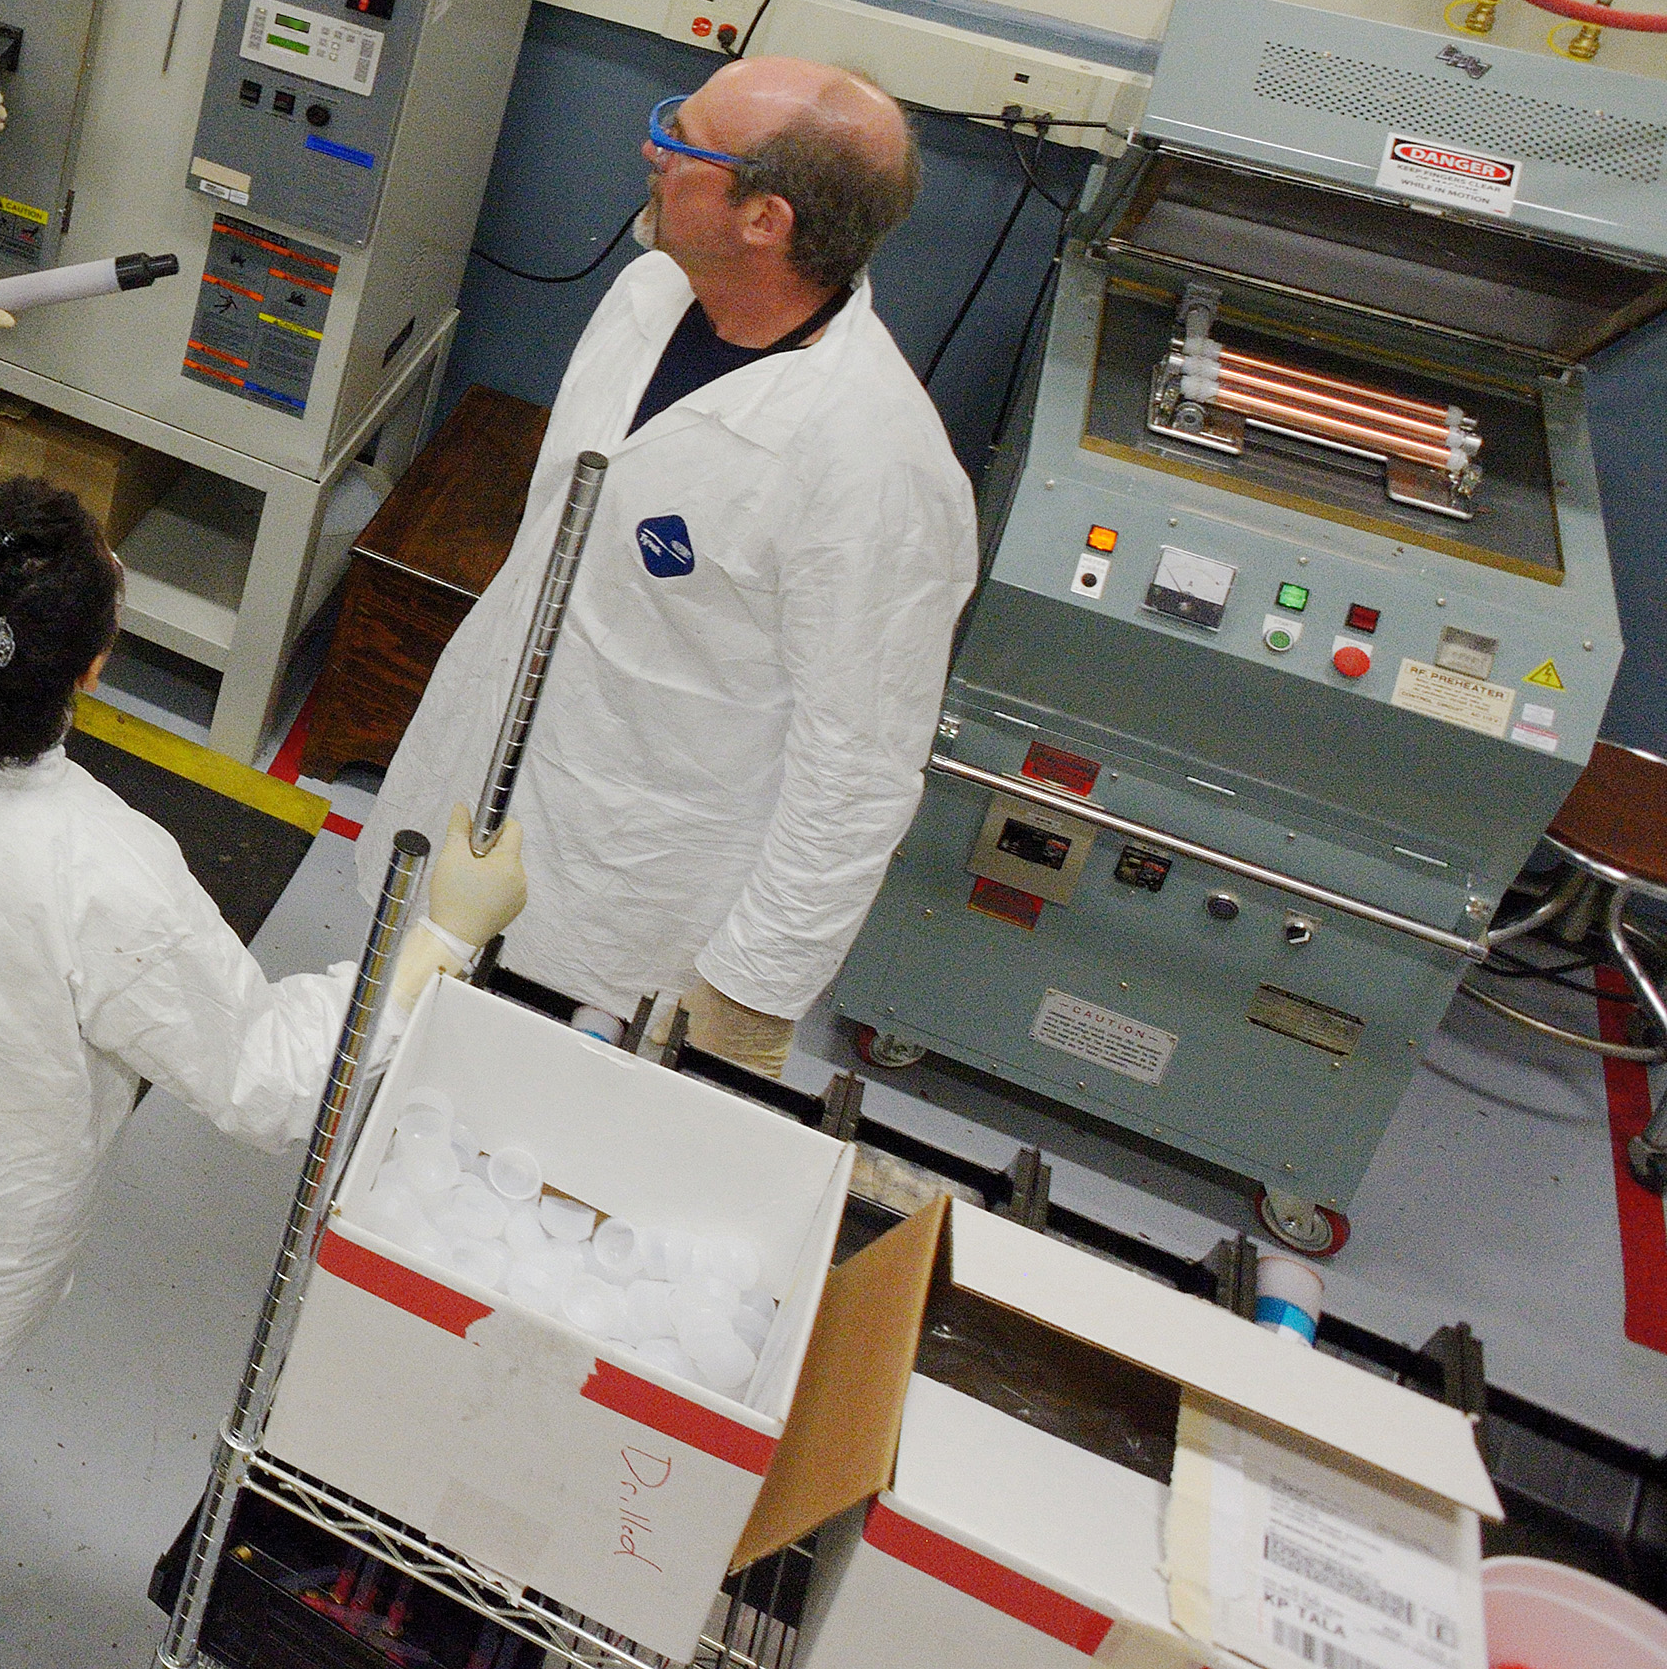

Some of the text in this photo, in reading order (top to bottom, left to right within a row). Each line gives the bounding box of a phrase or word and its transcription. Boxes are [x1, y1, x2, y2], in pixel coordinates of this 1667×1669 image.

[1409, 147, 1496, 178] DANGER
[1396, 164, 1501, 193] KEEP FINGERS CLEAR
[1400, 178, 1491, 205] WHILE IN MOTION
[5, 202, 44, 220] CAUTION
[1430, 672, 1505, 700] PREHEATER
[1071, 1004, 1147, 1040] CAUTION
